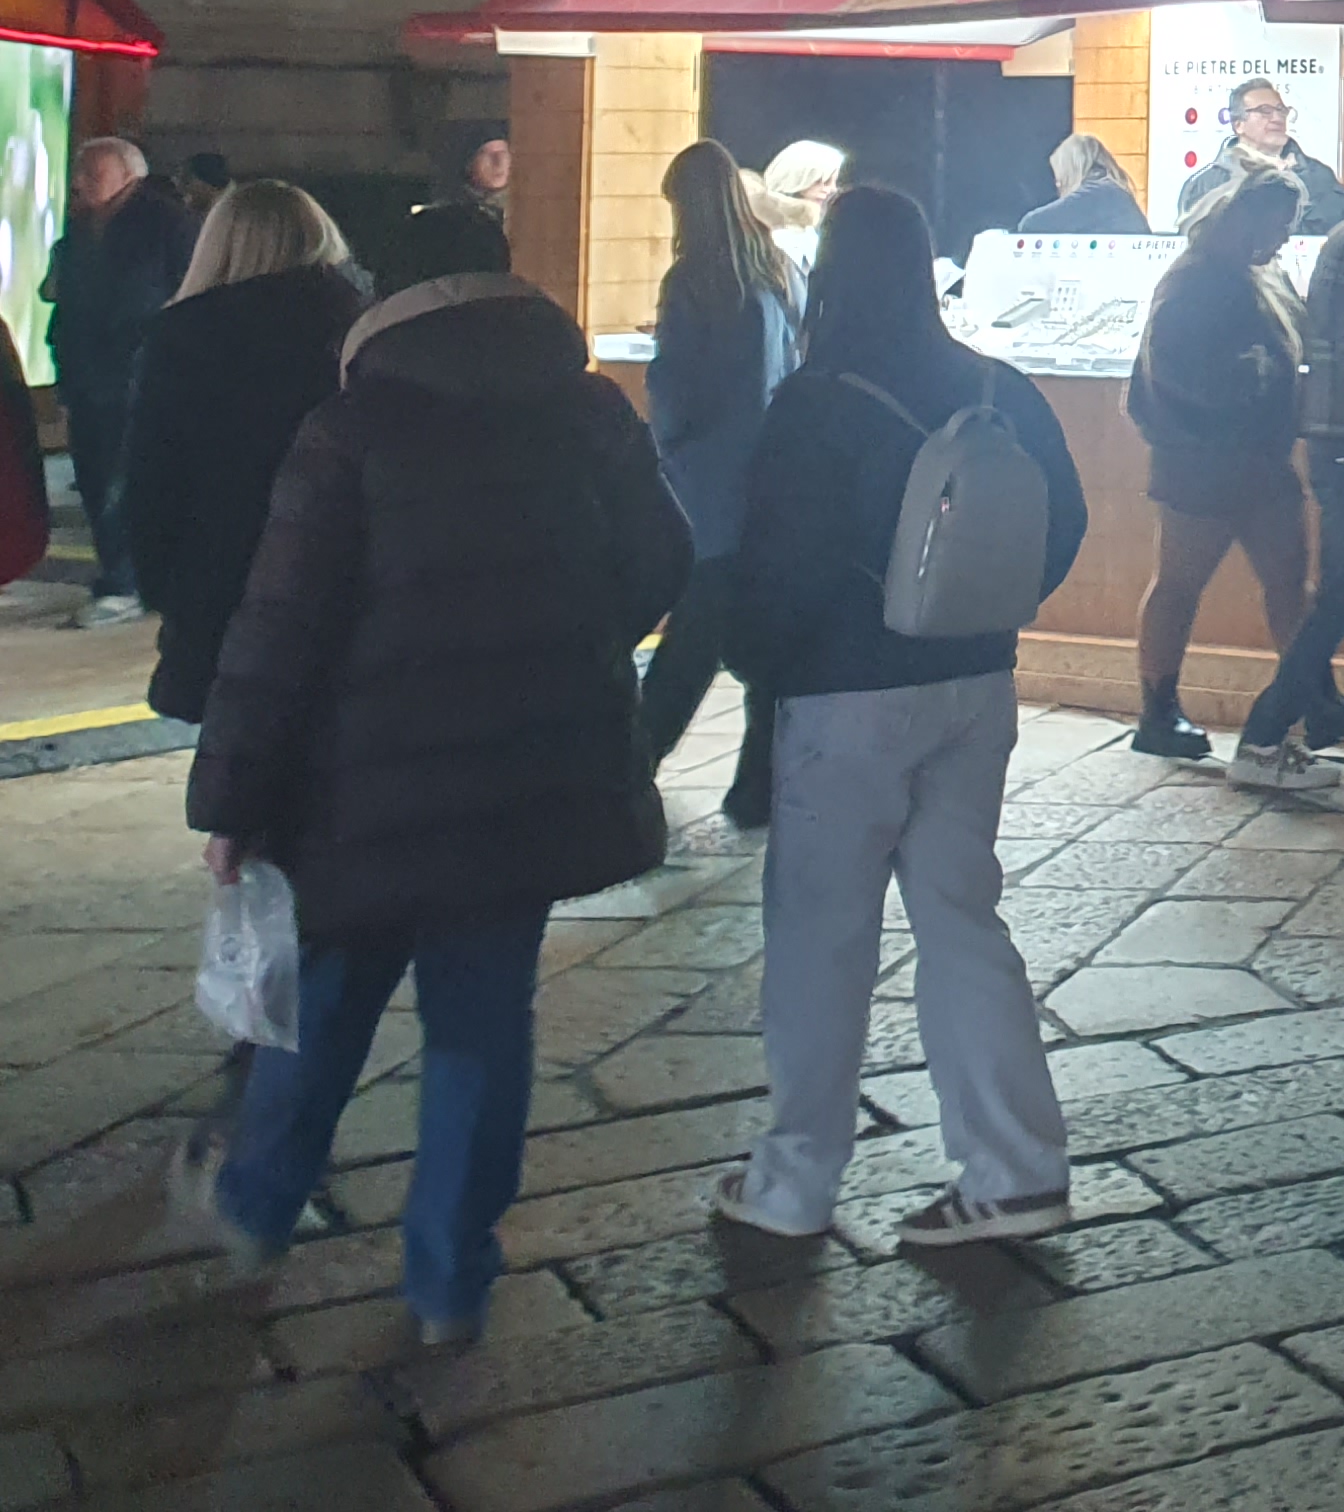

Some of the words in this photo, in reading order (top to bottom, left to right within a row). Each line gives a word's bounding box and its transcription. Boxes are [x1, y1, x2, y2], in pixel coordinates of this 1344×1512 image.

[1165, 61, 1179, 75] LE
[1187, 60, 1236, 75] PIETRE
[1243, 59, 1271, 74] DEL
